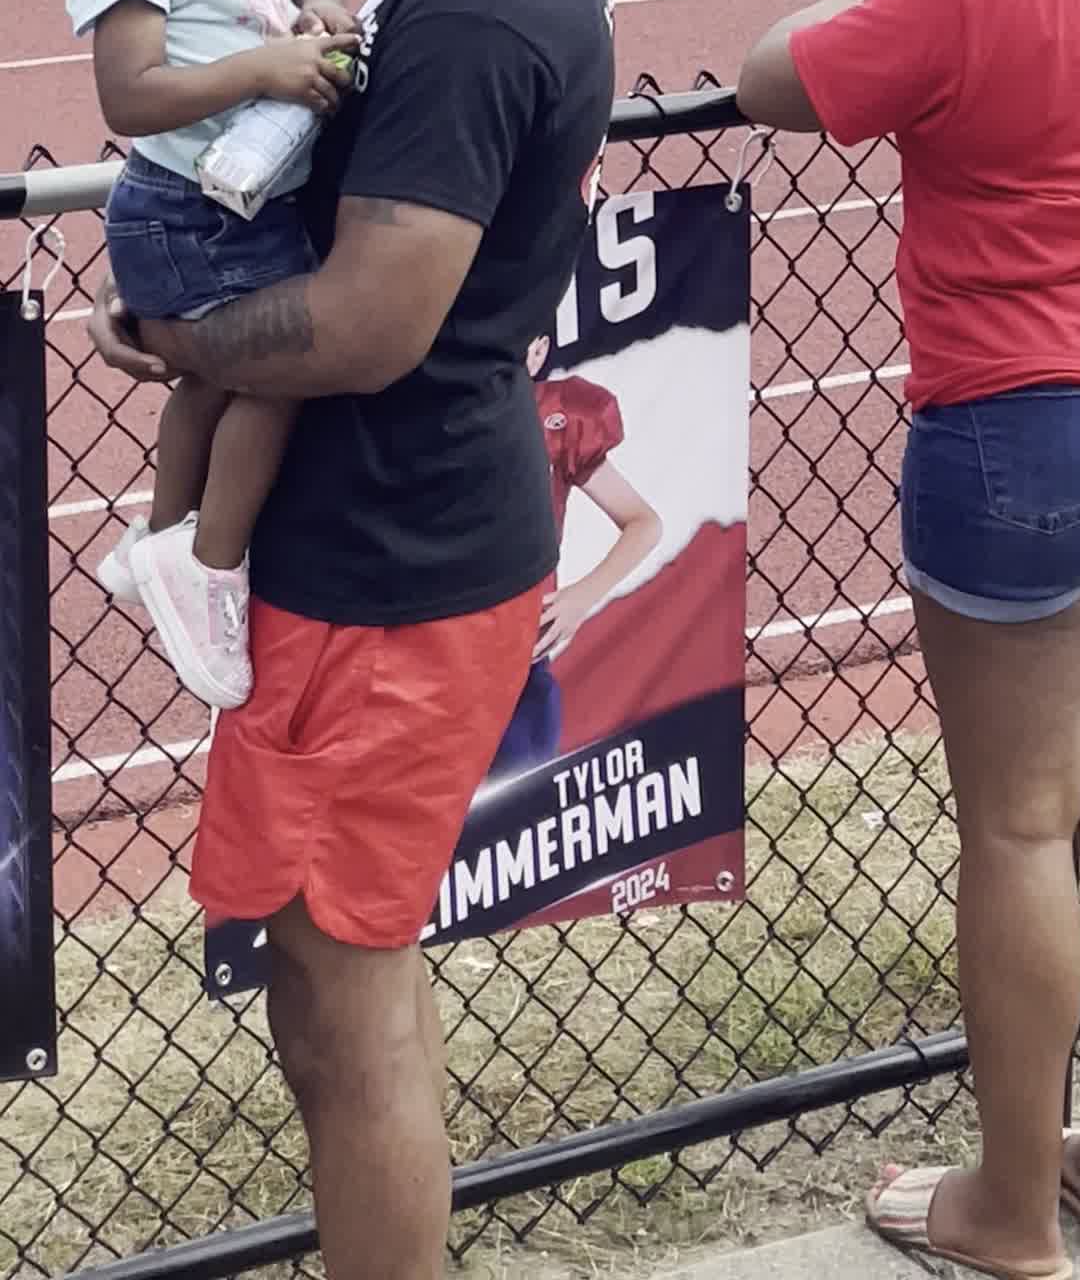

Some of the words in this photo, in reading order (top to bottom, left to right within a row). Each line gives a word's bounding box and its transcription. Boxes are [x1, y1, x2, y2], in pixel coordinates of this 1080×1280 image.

[553, 739, 644, 809] TYLOR
[420, 756, 702, 941] IMMERMAN
[611, 861, 670, 914] 2024
